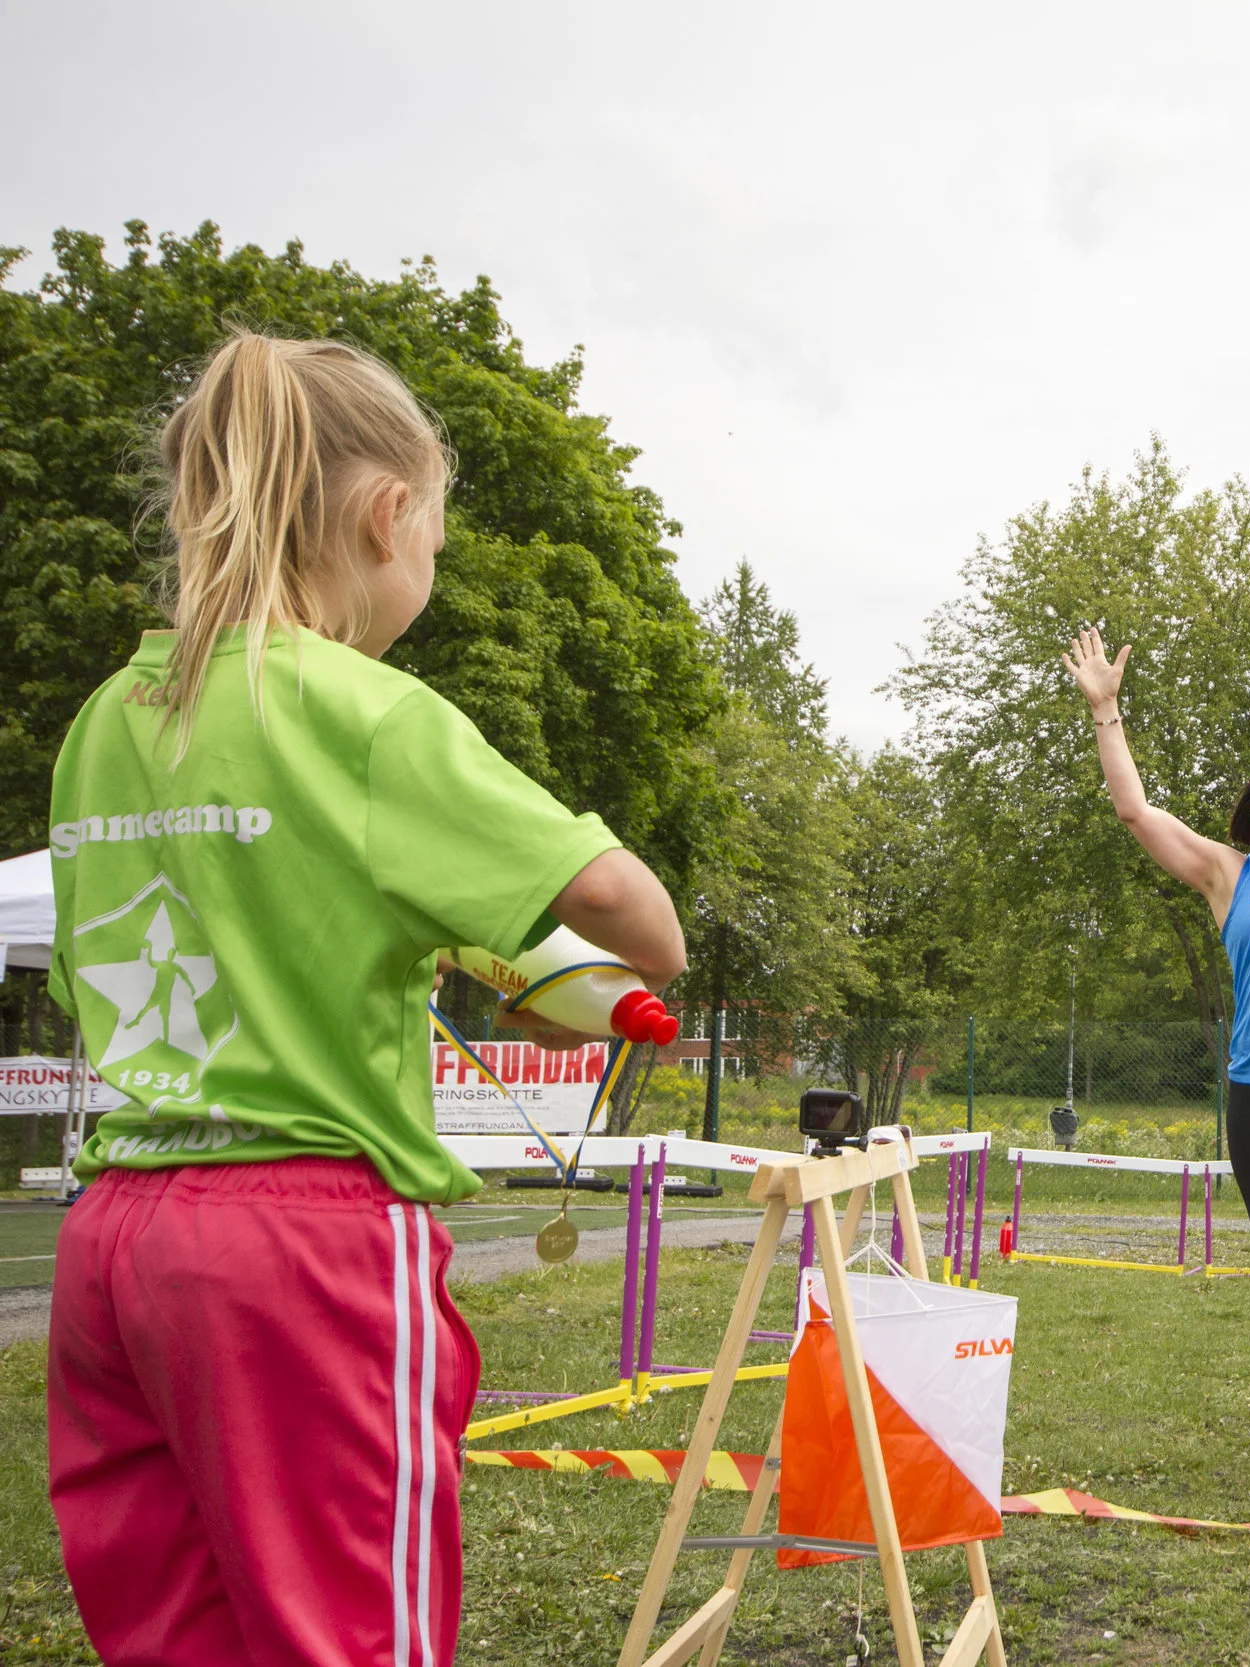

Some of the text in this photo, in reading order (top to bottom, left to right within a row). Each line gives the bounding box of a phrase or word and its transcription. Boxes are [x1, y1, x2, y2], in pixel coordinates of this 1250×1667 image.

[491, 959, 528, 991] TEAM
[432, 1044, 605, 1084] FFRUNDAN
[119, 1069, 190, 1094] 1934
[731, 1153, 758, 1166] POLANIK
[954, 1337, 1014, 1359] SILVA
